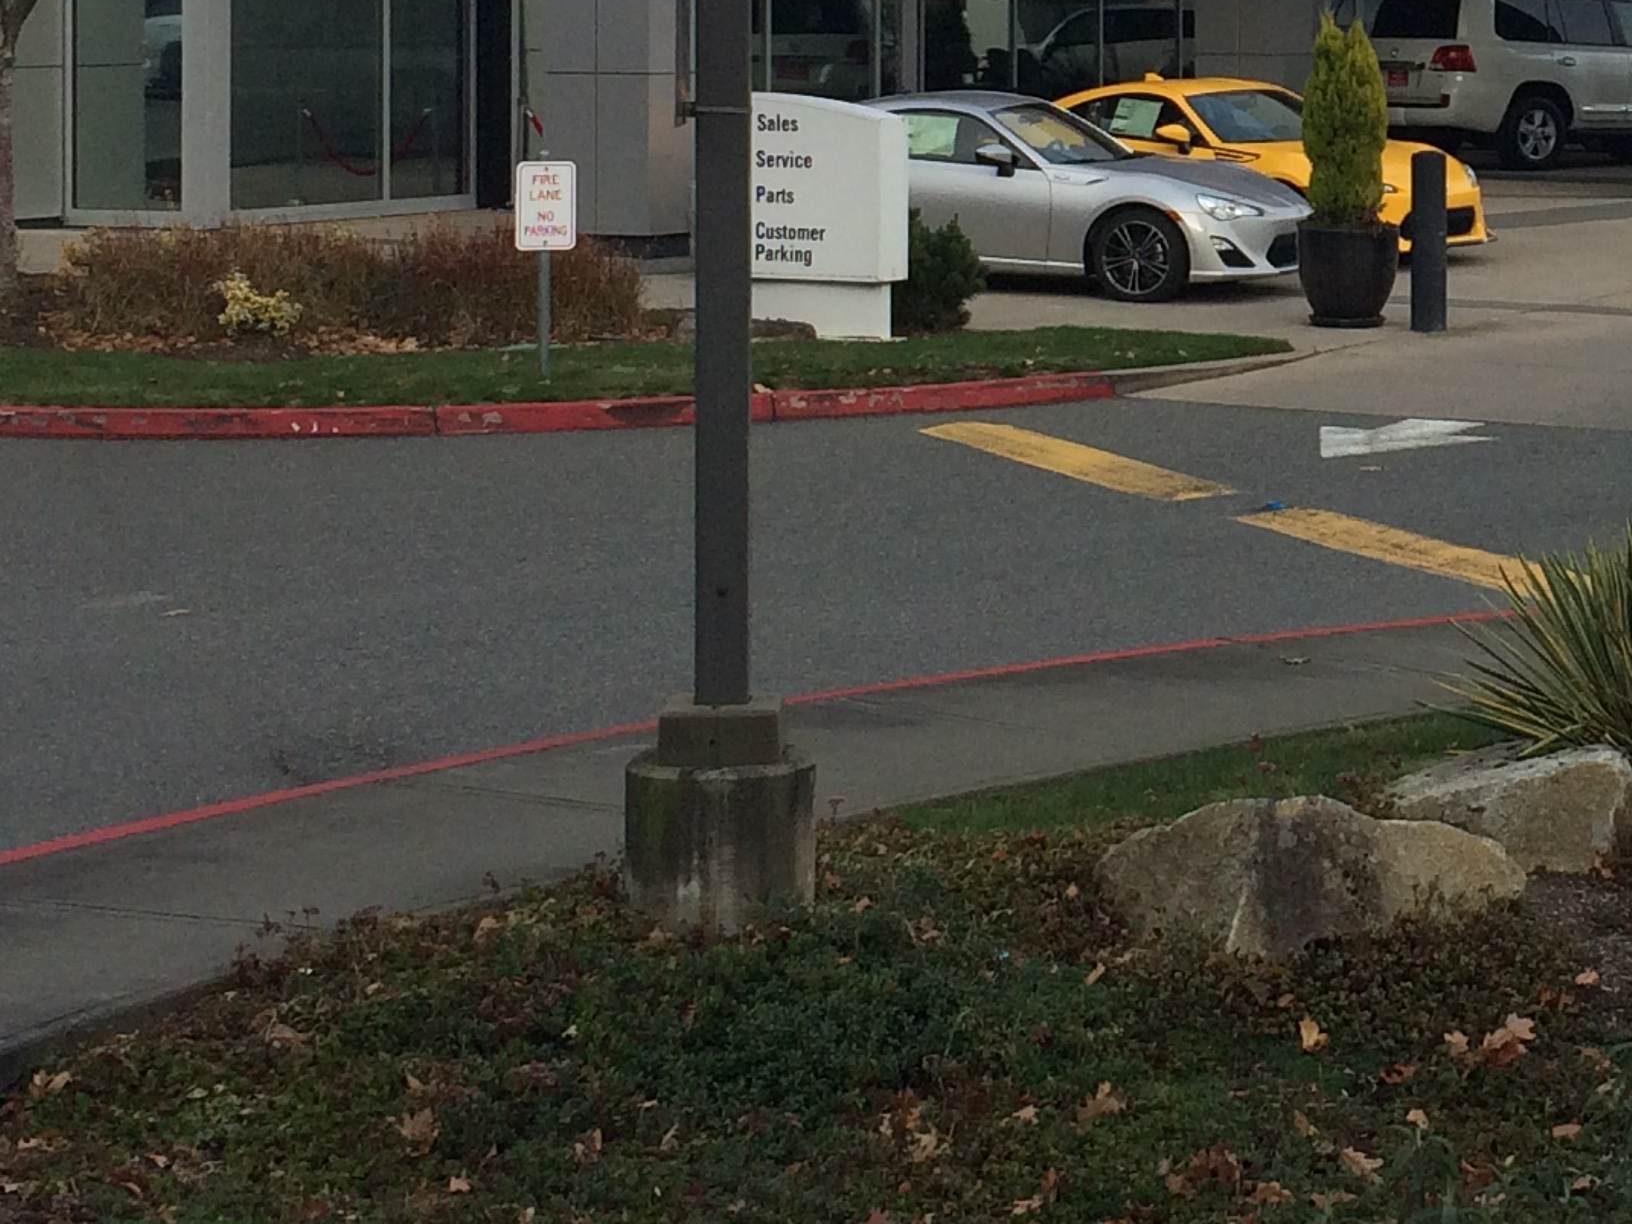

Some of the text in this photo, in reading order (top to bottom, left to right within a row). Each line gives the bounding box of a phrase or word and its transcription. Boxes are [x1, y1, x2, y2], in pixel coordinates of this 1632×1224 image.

[757, 114, 799, 132] Sales
[756, 150, 813, 169] Service
[532, 175, 560, 185] FIRE
[530, 190, 562, 201] LANE
[756, 186, 795, 204] Parts
[537, 211, 555, 222] NO
[524, 225, 568, 236] PARKING
[755, 222, 827, 241] Customer
[755, 244, 813, 267] Parking
